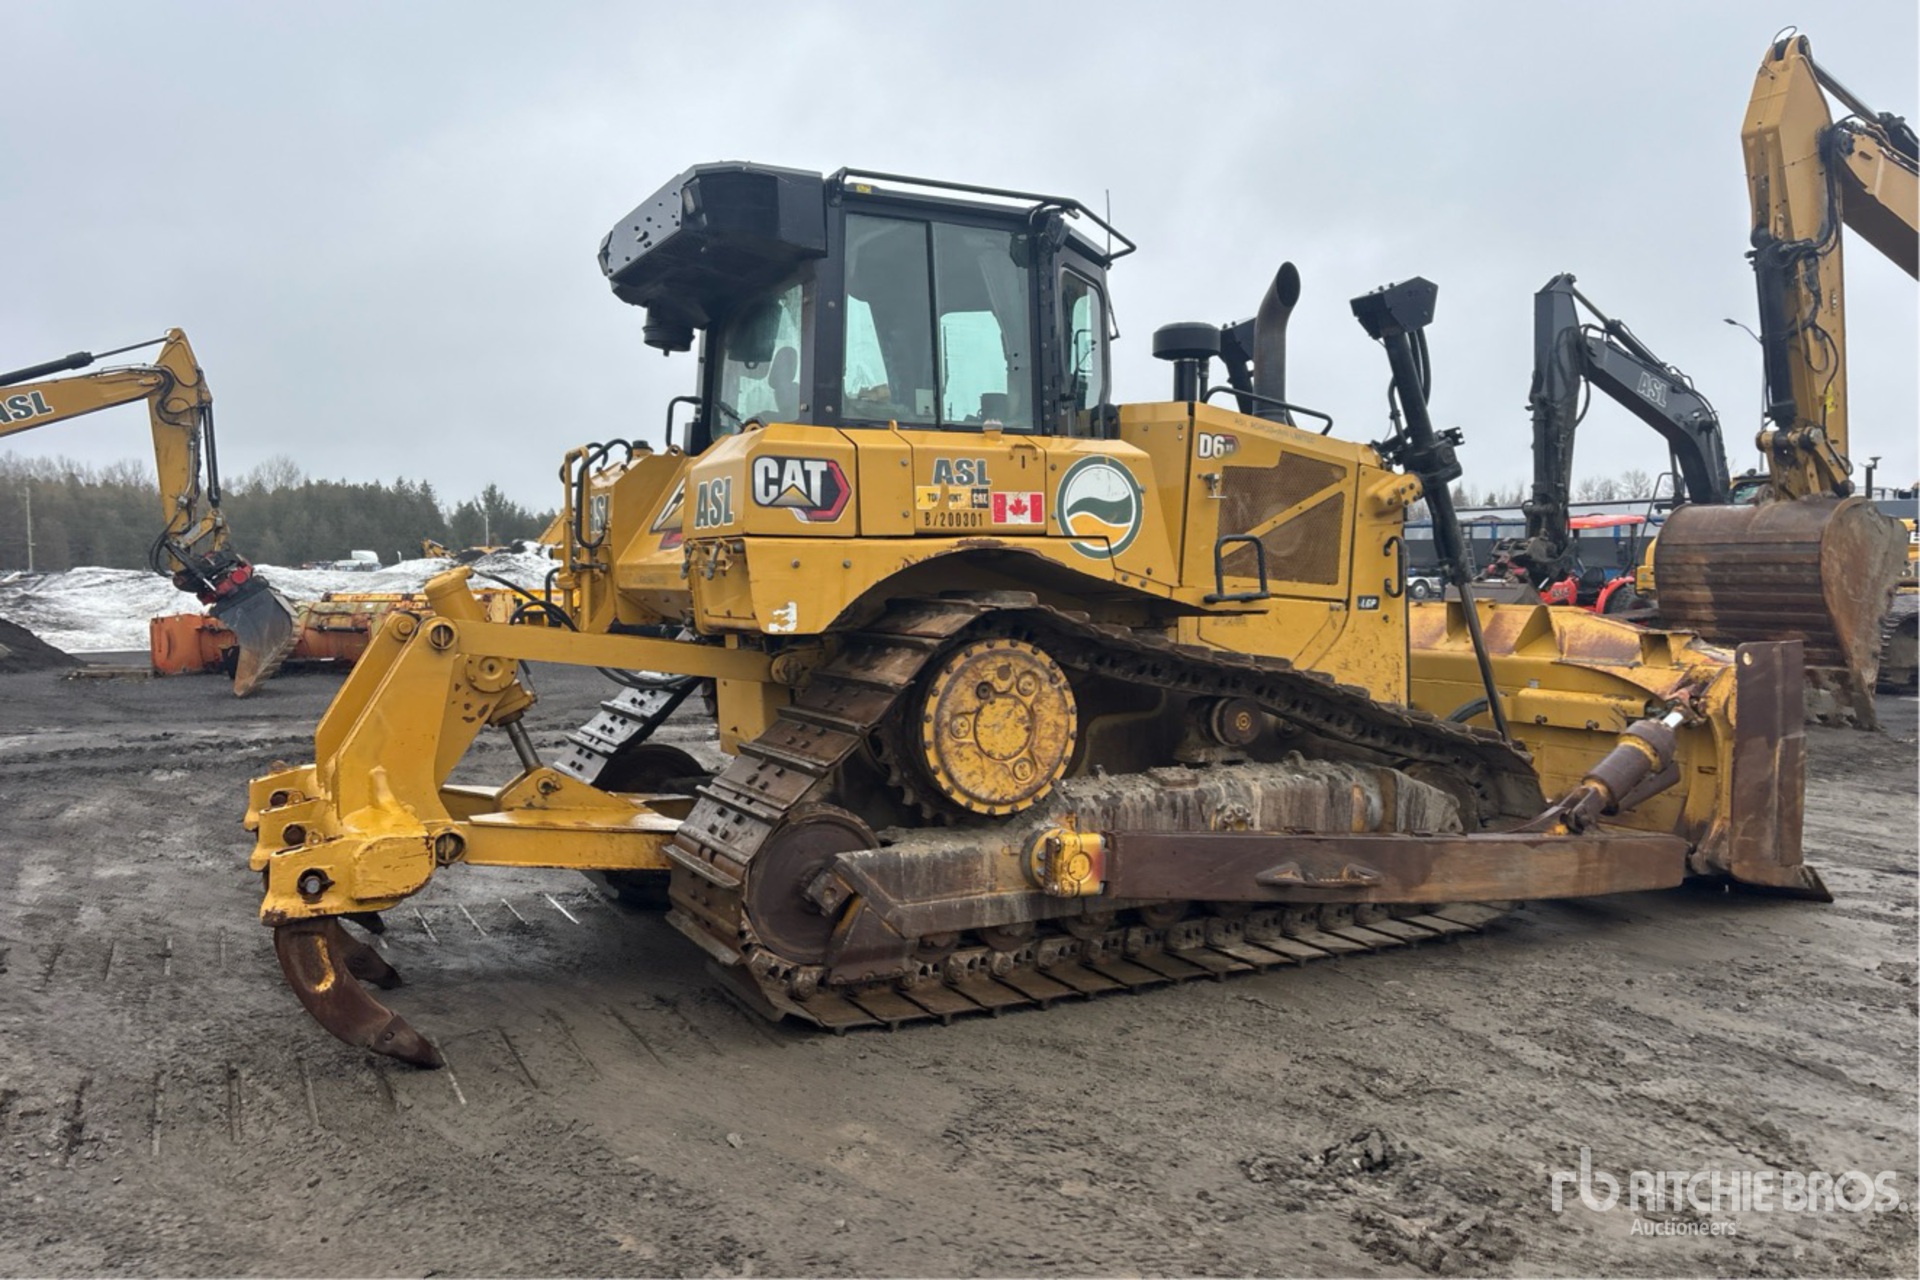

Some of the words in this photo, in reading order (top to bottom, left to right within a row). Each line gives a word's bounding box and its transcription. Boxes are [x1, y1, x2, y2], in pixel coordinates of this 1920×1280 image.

[1637, 371, 1667, 408] ASL
[1198, 432, 1225, 459] D6
[754, 457, 828, 507] CAT
[932, 458, 992, 485] ASL
[694, 476, 734, 529] ASL
[924, 511, 983, 527] B/200301
